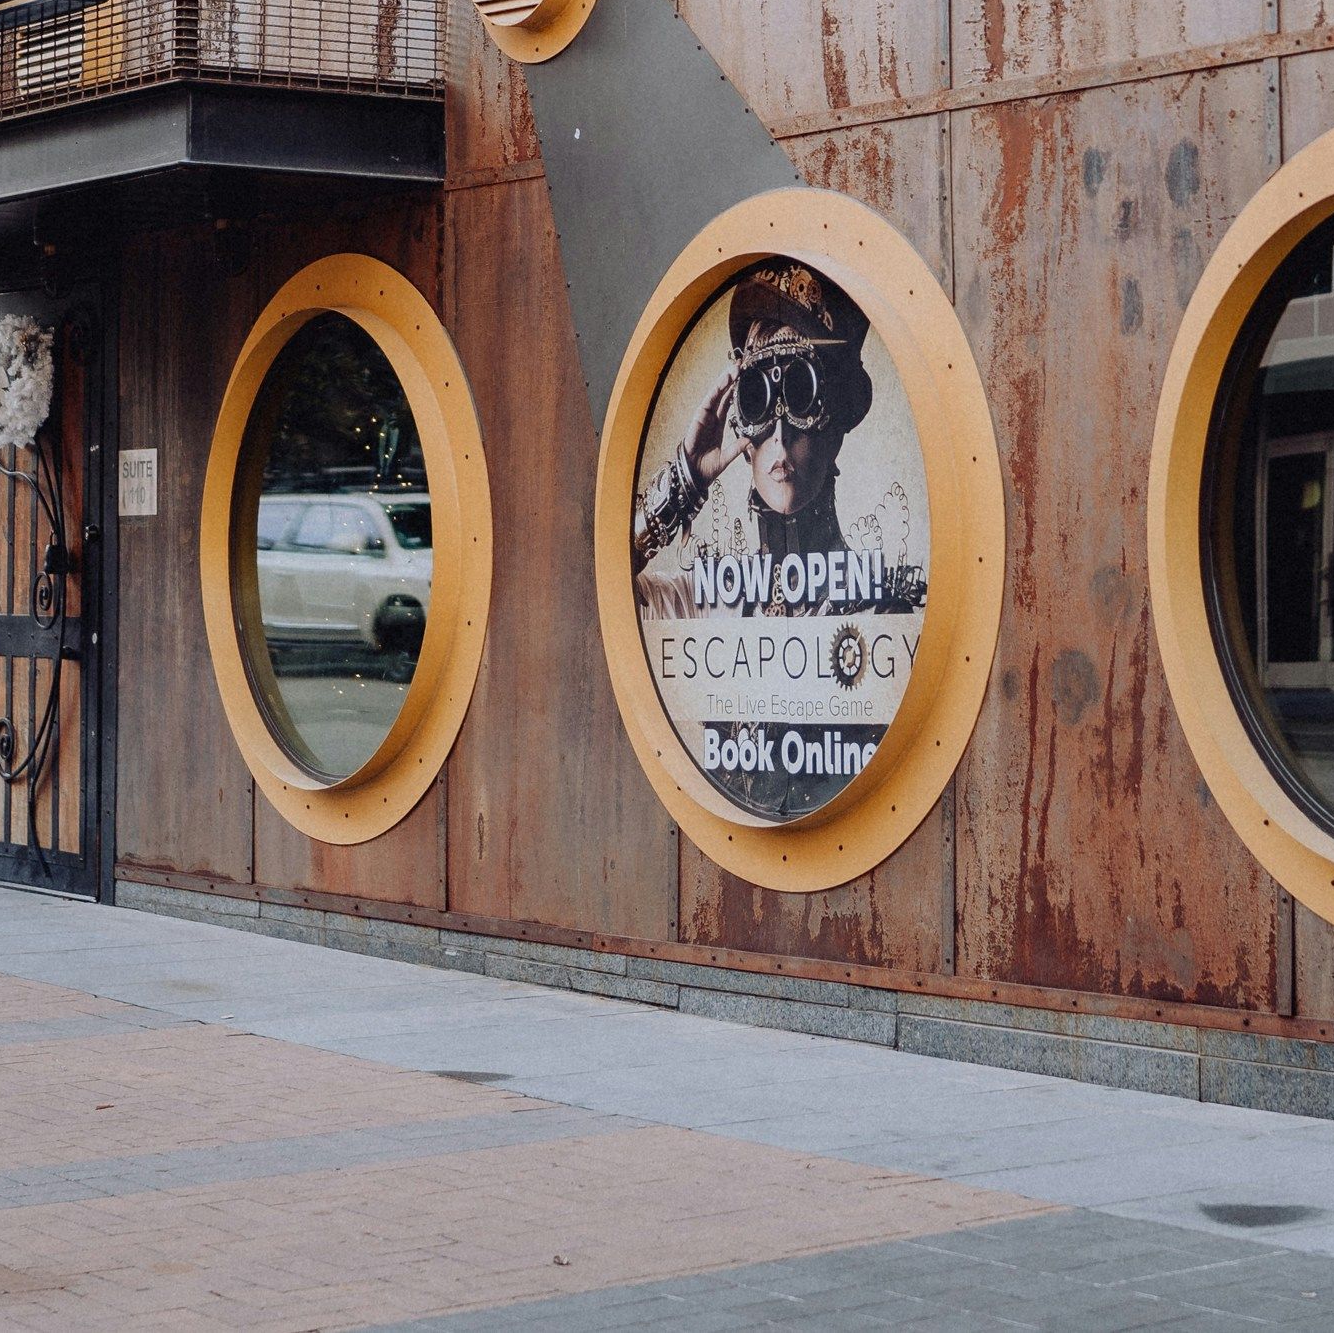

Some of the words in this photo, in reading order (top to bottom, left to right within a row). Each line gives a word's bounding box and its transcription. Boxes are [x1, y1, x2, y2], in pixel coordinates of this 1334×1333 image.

[123, 460, 153, 479] SUITE
[694, 552, 773, 604] NOW
[781, 549, 884, 604] OPEN!
[661, 633, 921, 680] ESCAPOLOGY
[707, 694, 733, 715] The
[738, 695, 767, 716] Live
[771, 694, 824, 721] Escape
[829, 696, 874, 717] Game
[704, 728, 775, 772] Book
